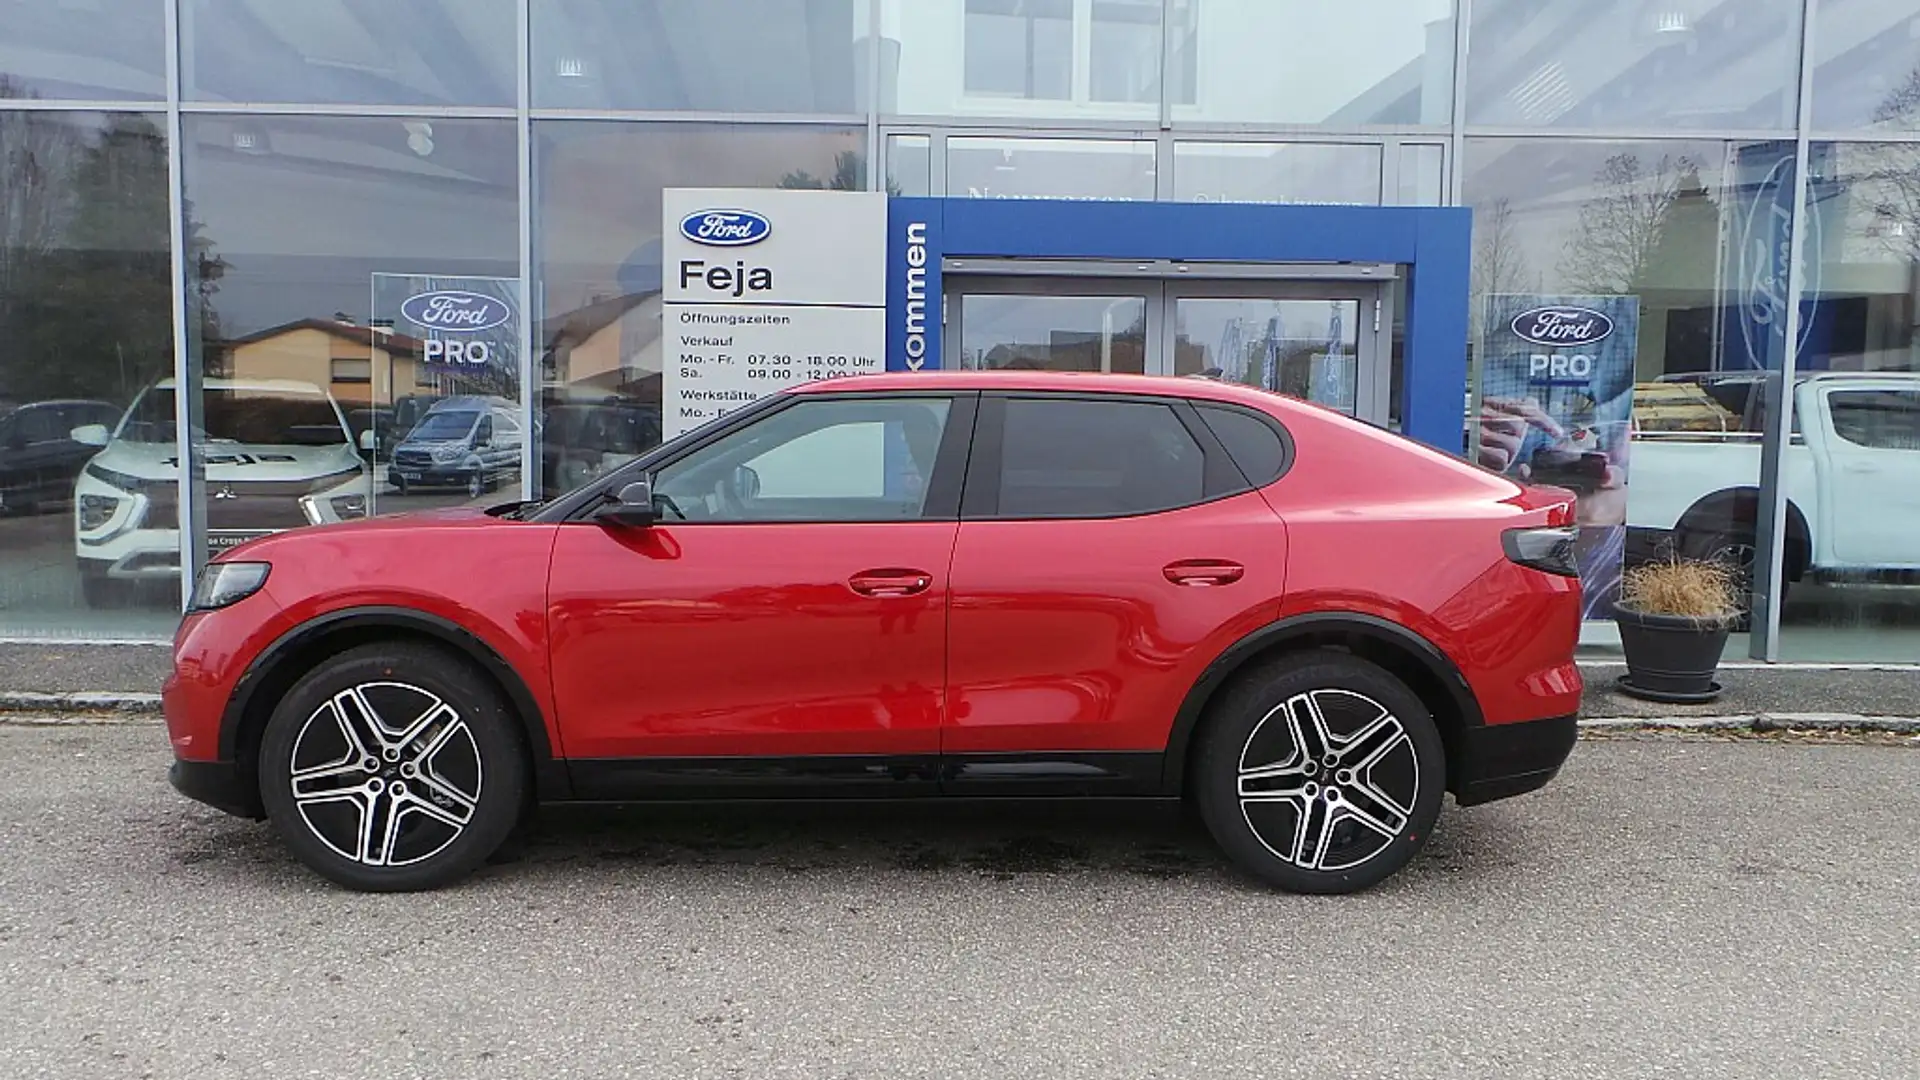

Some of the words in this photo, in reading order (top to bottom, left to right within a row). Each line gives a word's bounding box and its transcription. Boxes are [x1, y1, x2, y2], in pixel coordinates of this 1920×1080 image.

[698, 213, 752, 238] Ford
[680, 260, 772, 297] Feja
[422, 296, 488, 324] Ford
[680, 312, 790, 326] Öffnungszeiten
[1531, 311, 1594, 339] Ford
[680, 335, 734, 347] Verkauf
[747, 355, 791, 365] 07.30
[852, 356, 876, 367] Uhr
[680, 367, 703, 378] Sa.
[747, 369, 791, 379] 09.00
[680, 389, 757, 401] Werkstätte
